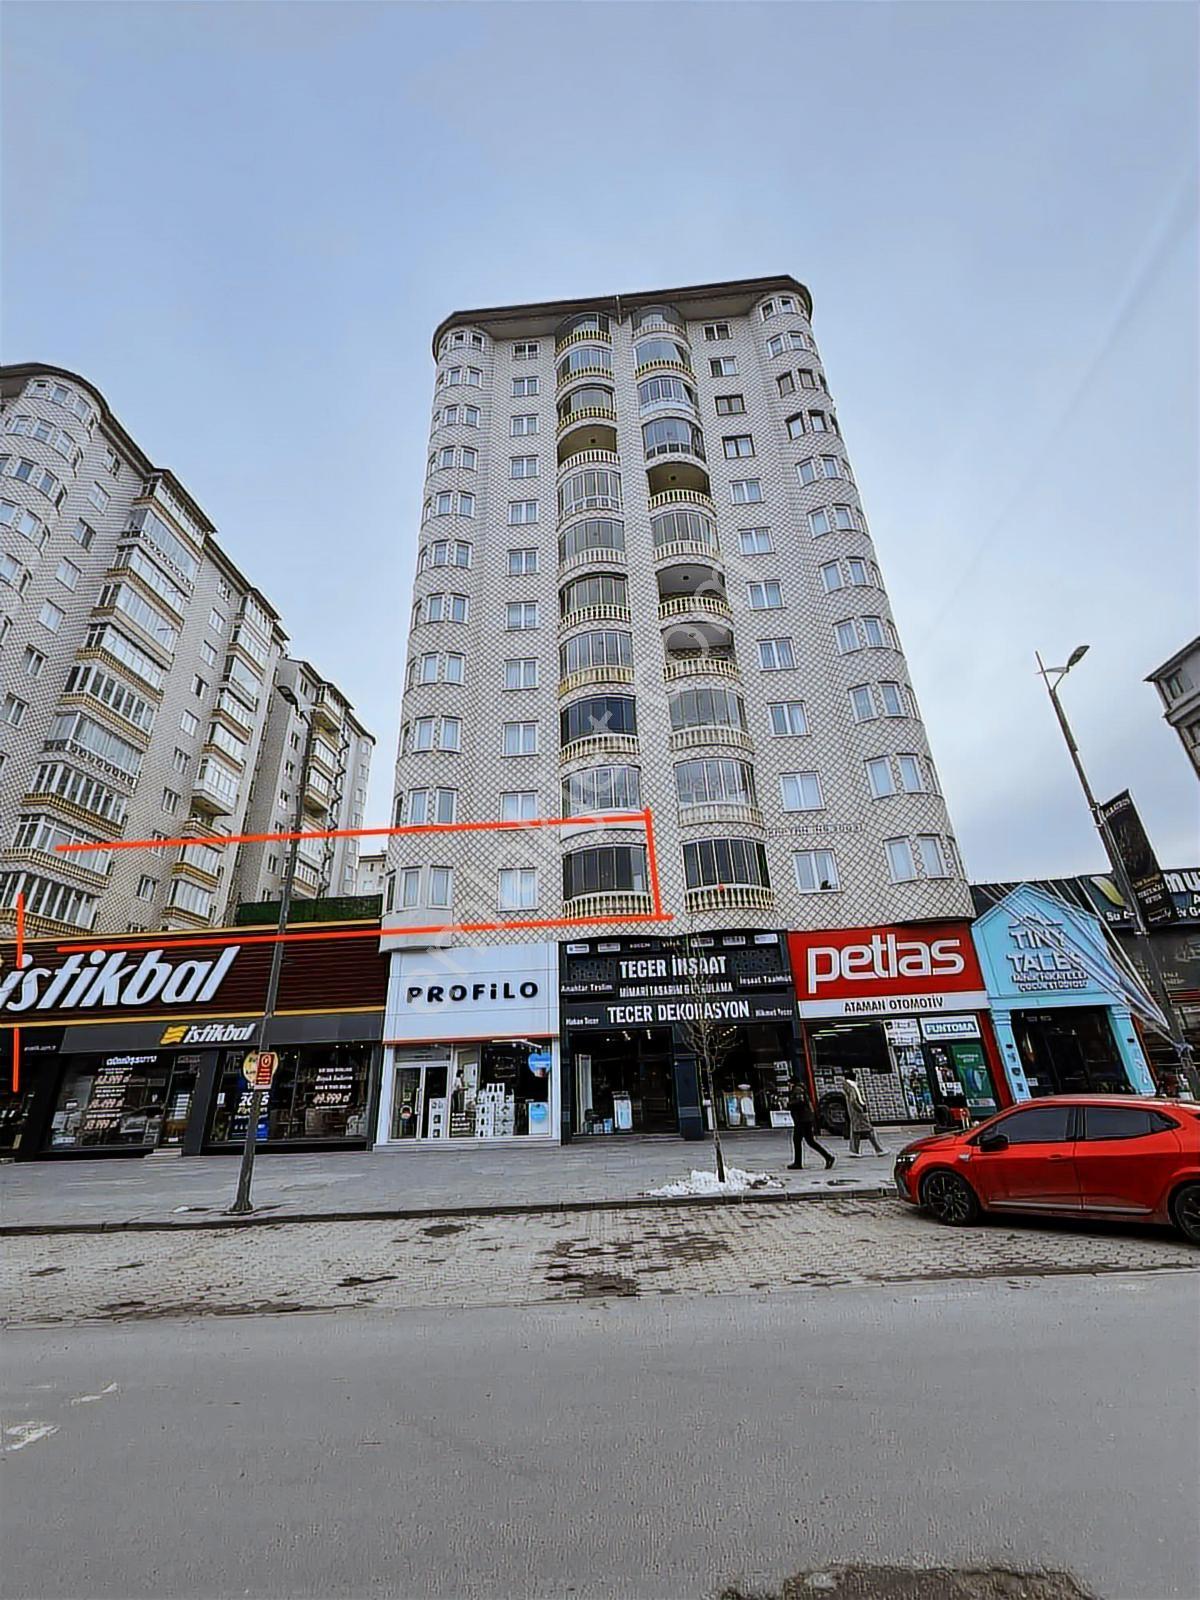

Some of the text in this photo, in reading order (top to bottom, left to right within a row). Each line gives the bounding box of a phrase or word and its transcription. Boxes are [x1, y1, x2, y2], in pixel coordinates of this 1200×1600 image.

[620, 959, 667, 978] TECER
[807, 934, 965, 994] petlas
[0, 946, 241, 1012] istikbal
[607, 1005, 653, 1024] TECER
[844, 995, 943, 1014] ATAMAN OTOMOTİV
[183, 1023, 256, 1044] istikbal
